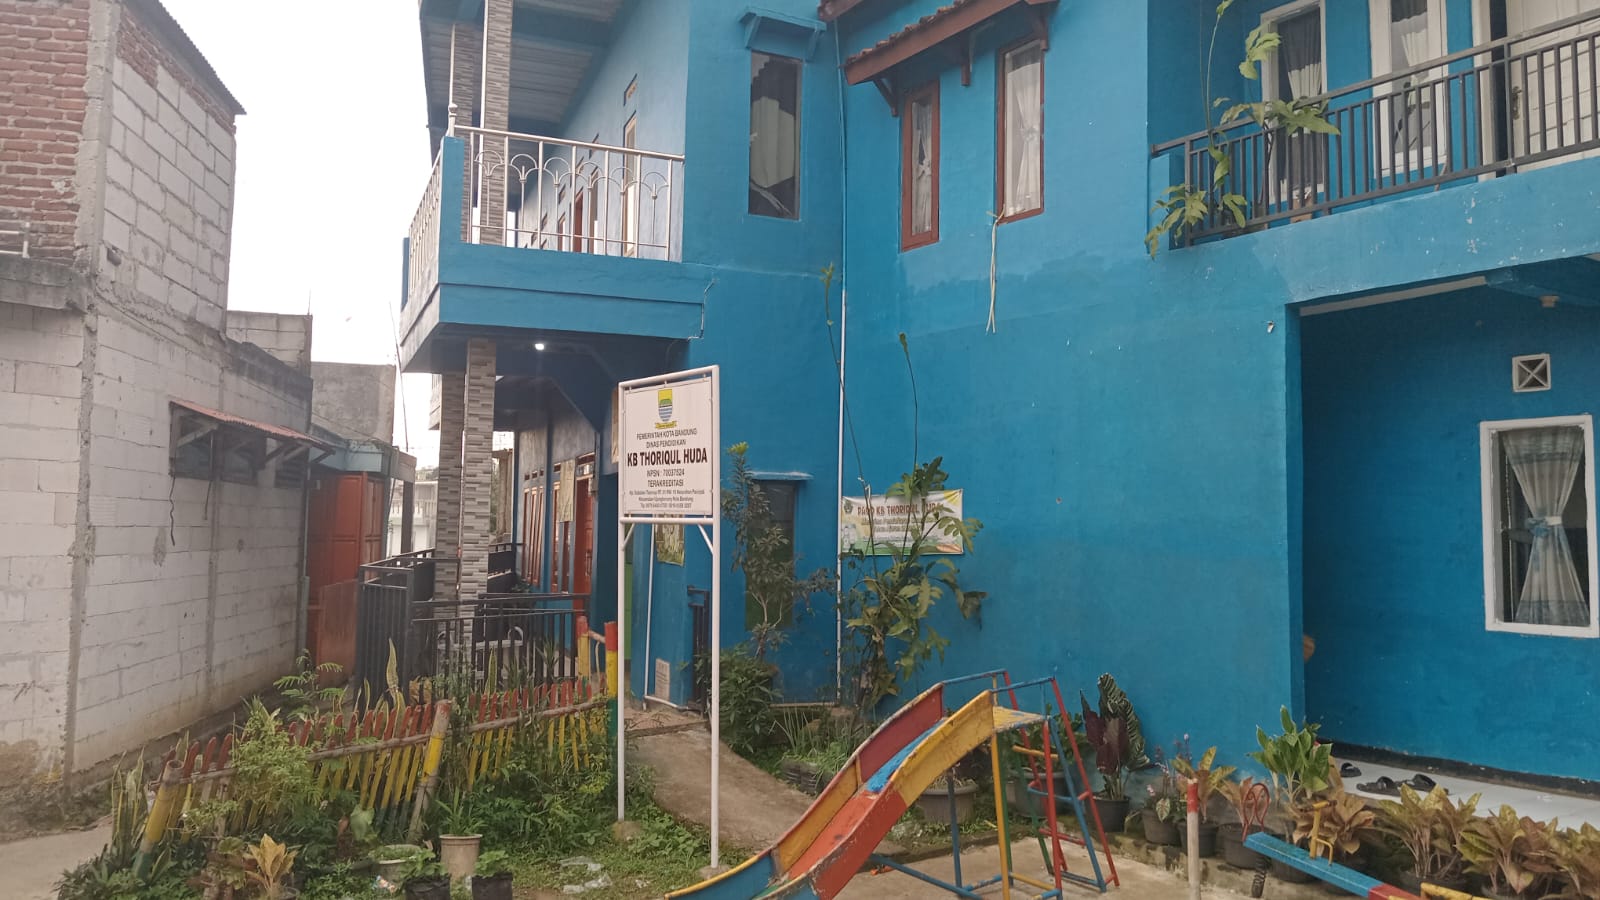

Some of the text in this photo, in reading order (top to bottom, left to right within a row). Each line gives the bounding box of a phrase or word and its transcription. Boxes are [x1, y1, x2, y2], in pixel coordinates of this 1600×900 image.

[637, 428, 697, 440] PEMERINTAH KOTA BANDUNG
[660, 439, 686, 447] PENDIDIKAN
[627, 447, 708, 467] KB THORIQUL HUDA
[647, 469, 660, 477] NPSN
[648, 479, 684, 487] TERAKREDITASI
